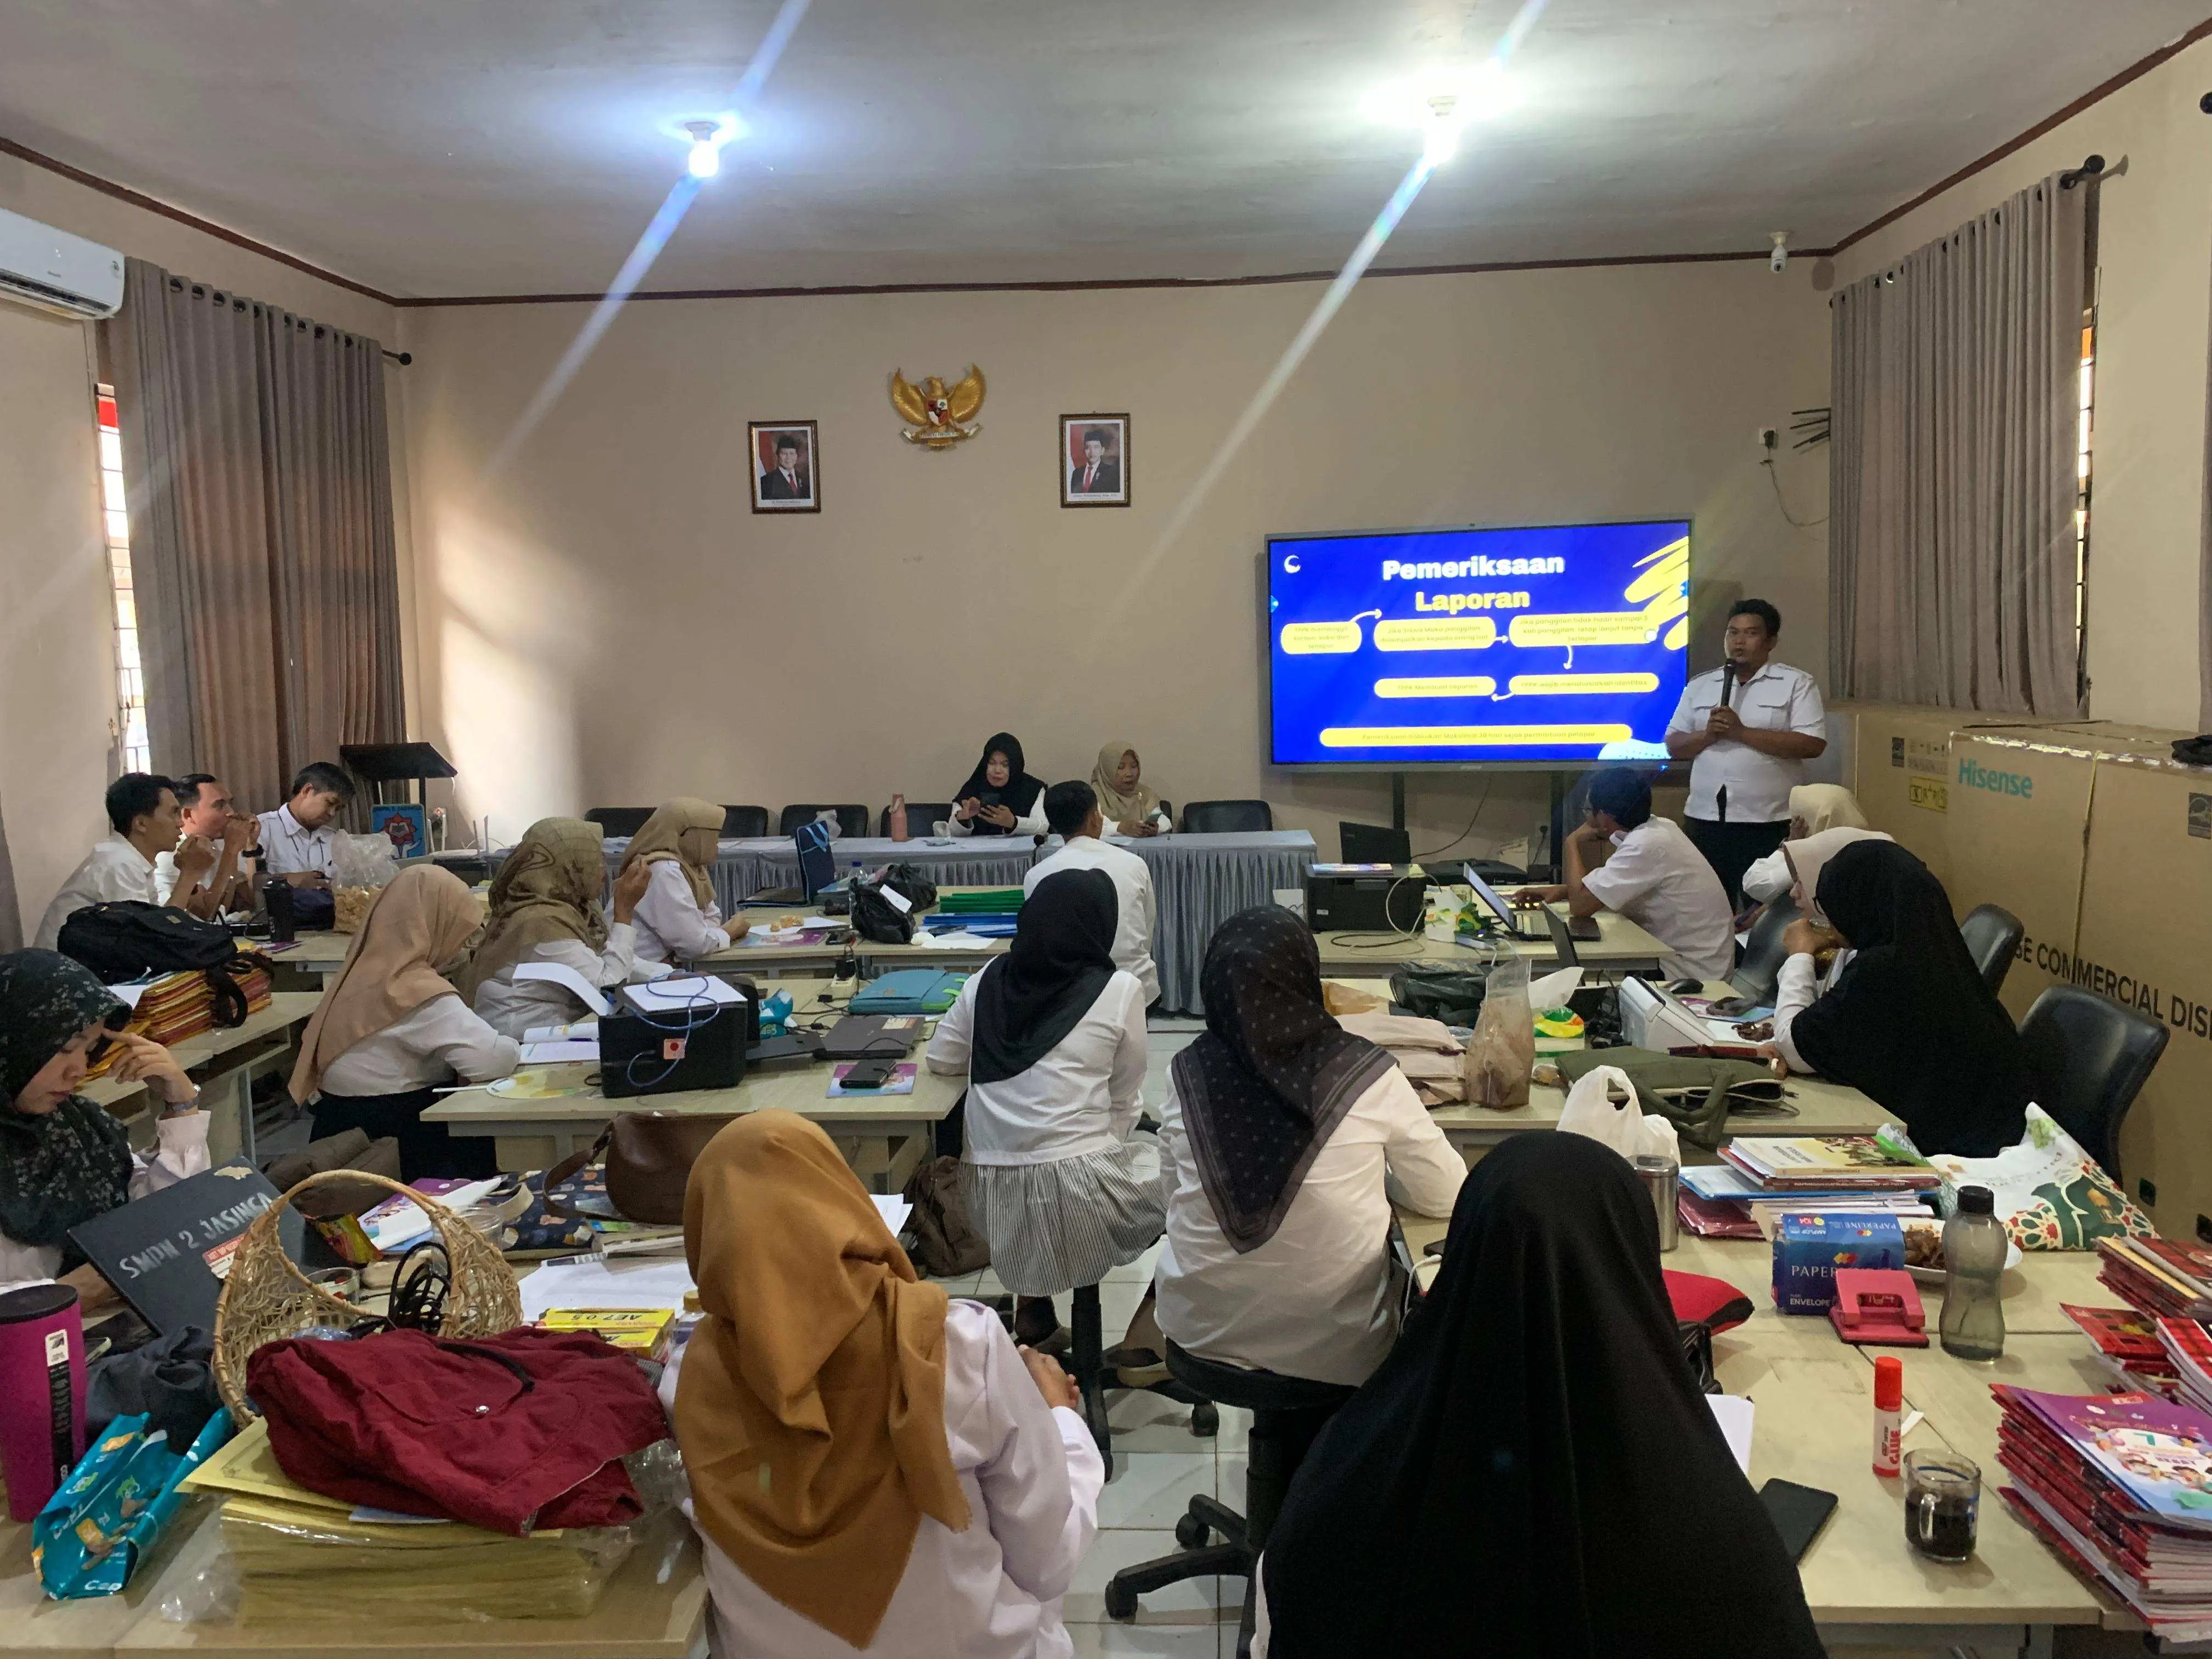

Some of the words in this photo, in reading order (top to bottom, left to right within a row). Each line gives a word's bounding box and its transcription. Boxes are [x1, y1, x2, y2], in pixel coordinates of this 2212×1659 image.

[1383, 556, 1564, 580] Pemeriksaan
[1415, 590, 1530, 615] Laporan
[1958, 758, 2033, 799] Hisense
[2036, 942, 2164, 1019] COMMERCIAL
[119, 1238, 181, 1279] SMPN
[178, 1230, 201, 1249] 2
[1889, 1431, 1900, 1464] GLUE
